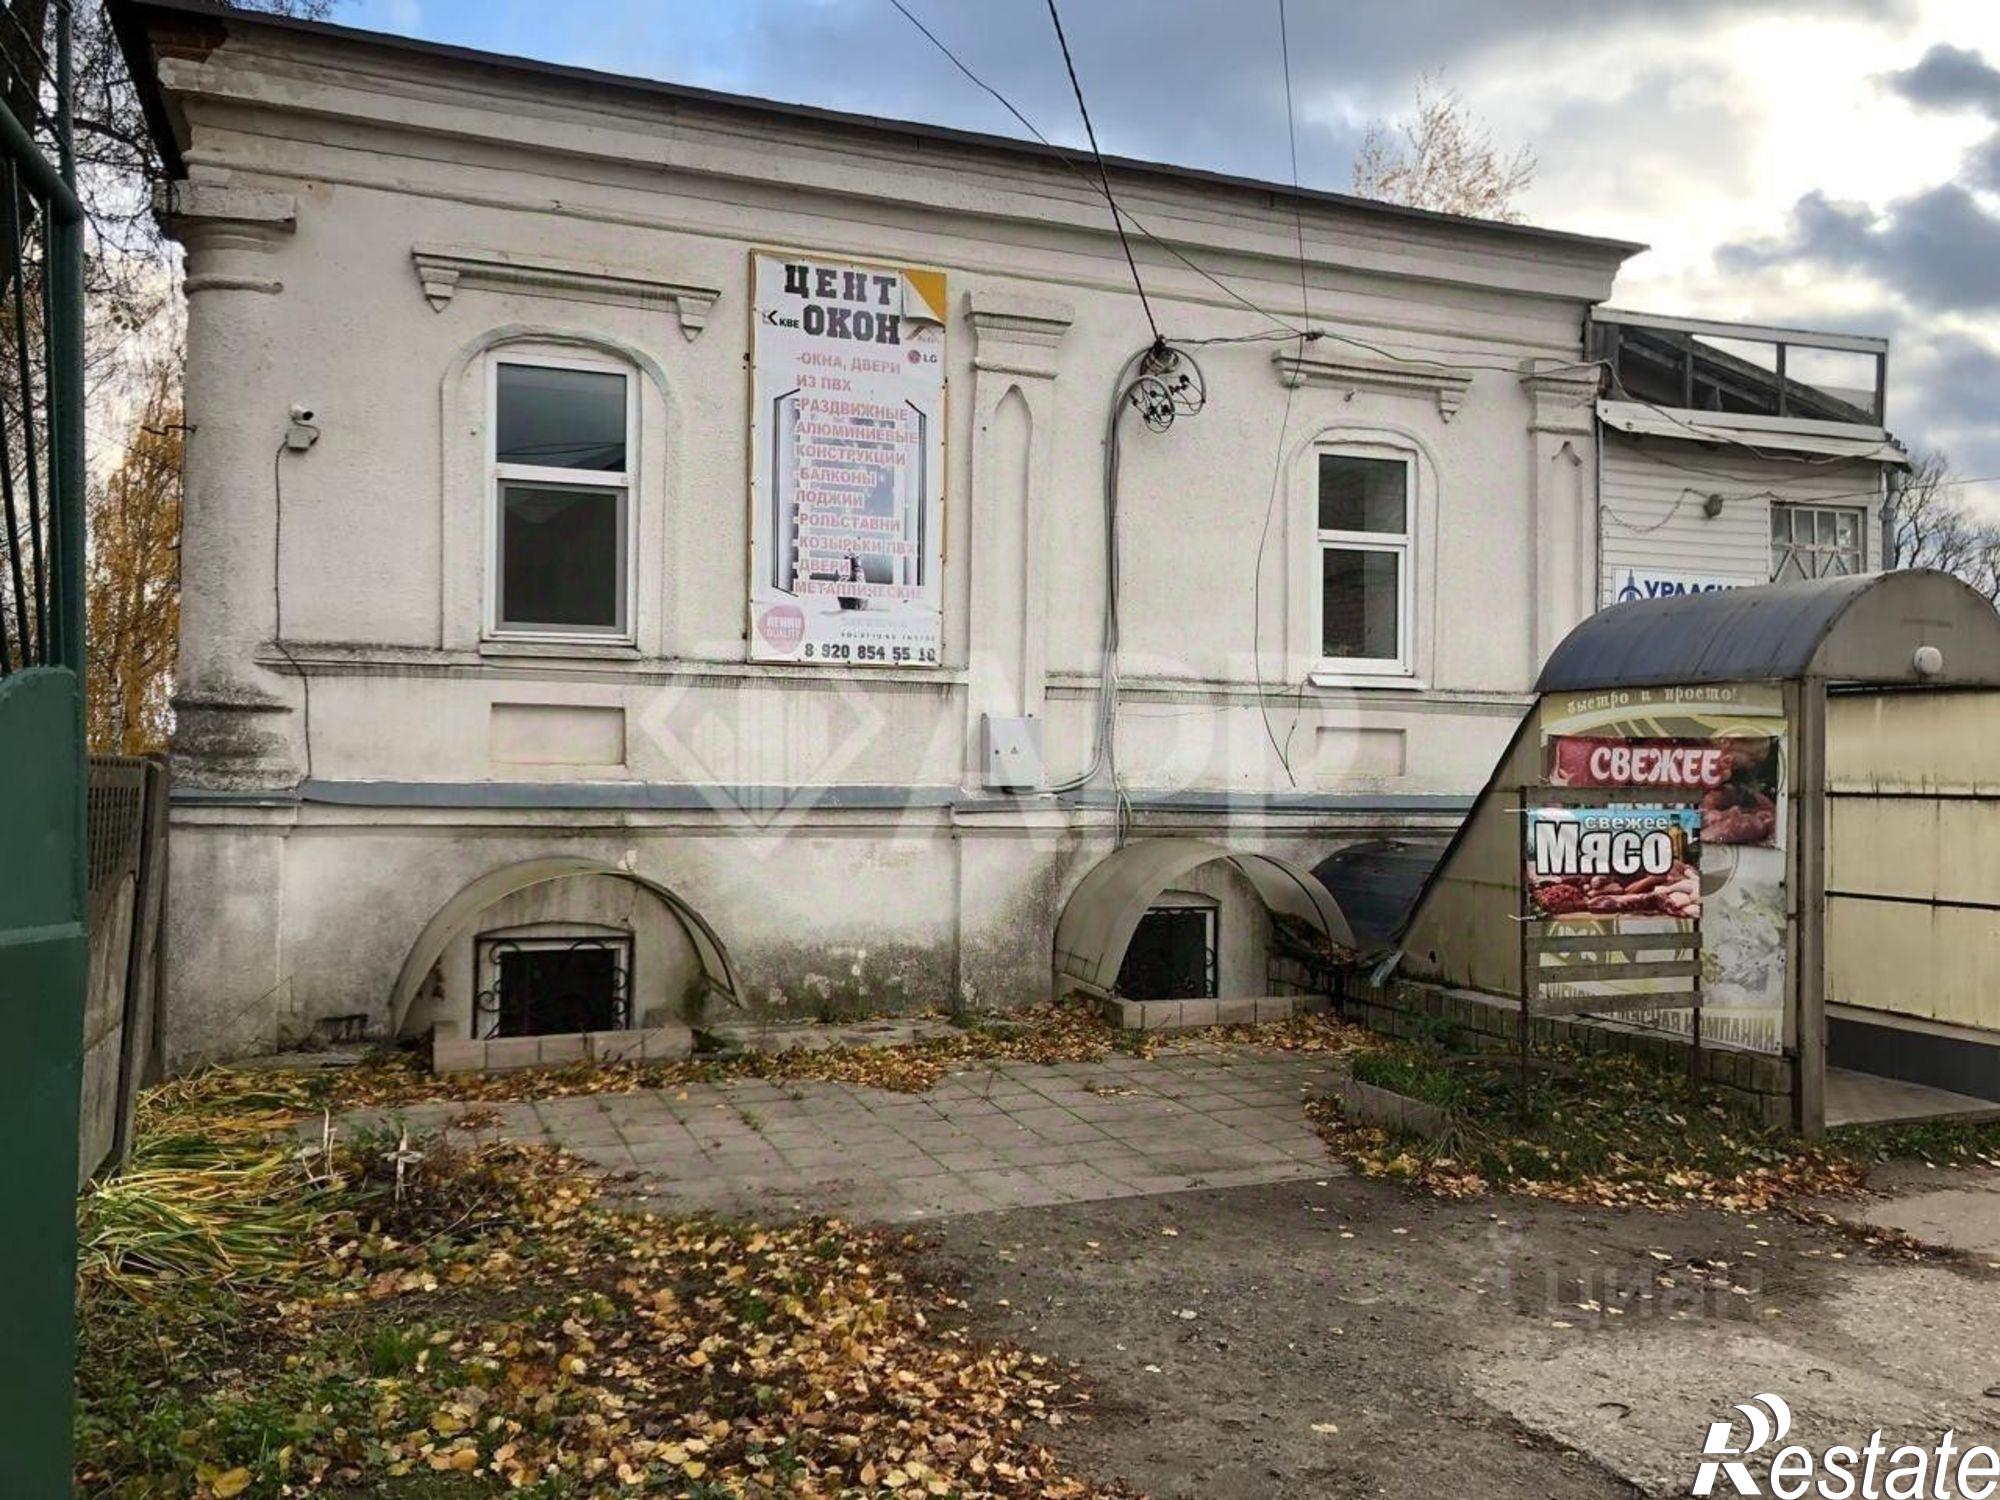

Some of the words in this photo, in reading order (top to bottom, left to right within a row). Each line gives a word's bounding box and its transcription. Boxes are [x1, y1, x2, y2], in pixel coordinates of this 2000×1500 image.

[803, 304, 900, 345] ОКОН
[851, 357, 901, 374] ДВЕРИ
[922, 353, 938, 363] LG
[796, 374, 816, 388] ИЗ
[820, 377, 852, 391] ПВХ
[796, 421, 918, 444] АЛЮМИНИЕВЫЕ
[796, 445, 906, 466] КОНСТРУКЦИИ
[804, 643, 814, 657] 8
[821, 643, 850, 658] 920
[857, 645, 885, 660] 854
[892, 647, 911, 660] 55
[1589, 745, 1722, 785] СВЕЖЕЕ
[1584, 816, 1668, 829] свежее
